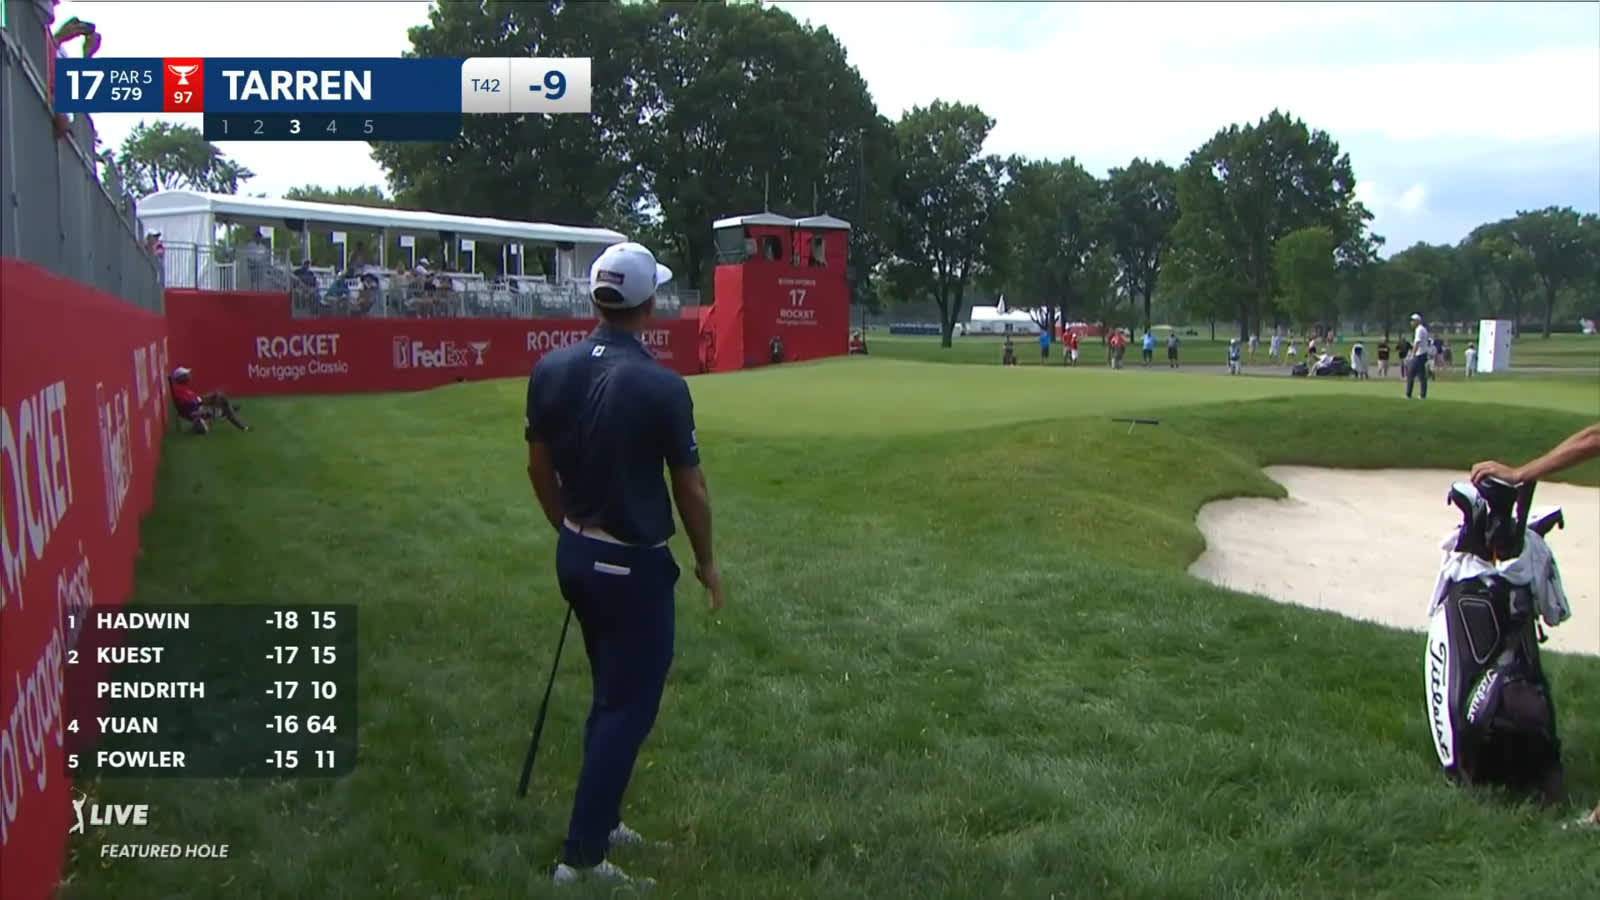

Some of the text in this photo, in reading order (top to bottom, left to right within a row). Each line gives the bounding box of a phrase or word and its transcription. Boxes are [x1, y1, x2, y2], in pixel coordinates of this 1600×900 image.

[790, 289, 806, 306] 17
[256, 334, 340, 359] ROCKET
[412, 341, 467, 367] FedEx
[248, 359, 348, 380] Mortgage Classic
[0, 380, 73, 612] OCKET
[1429, 640, 1451, 760] Titleist
